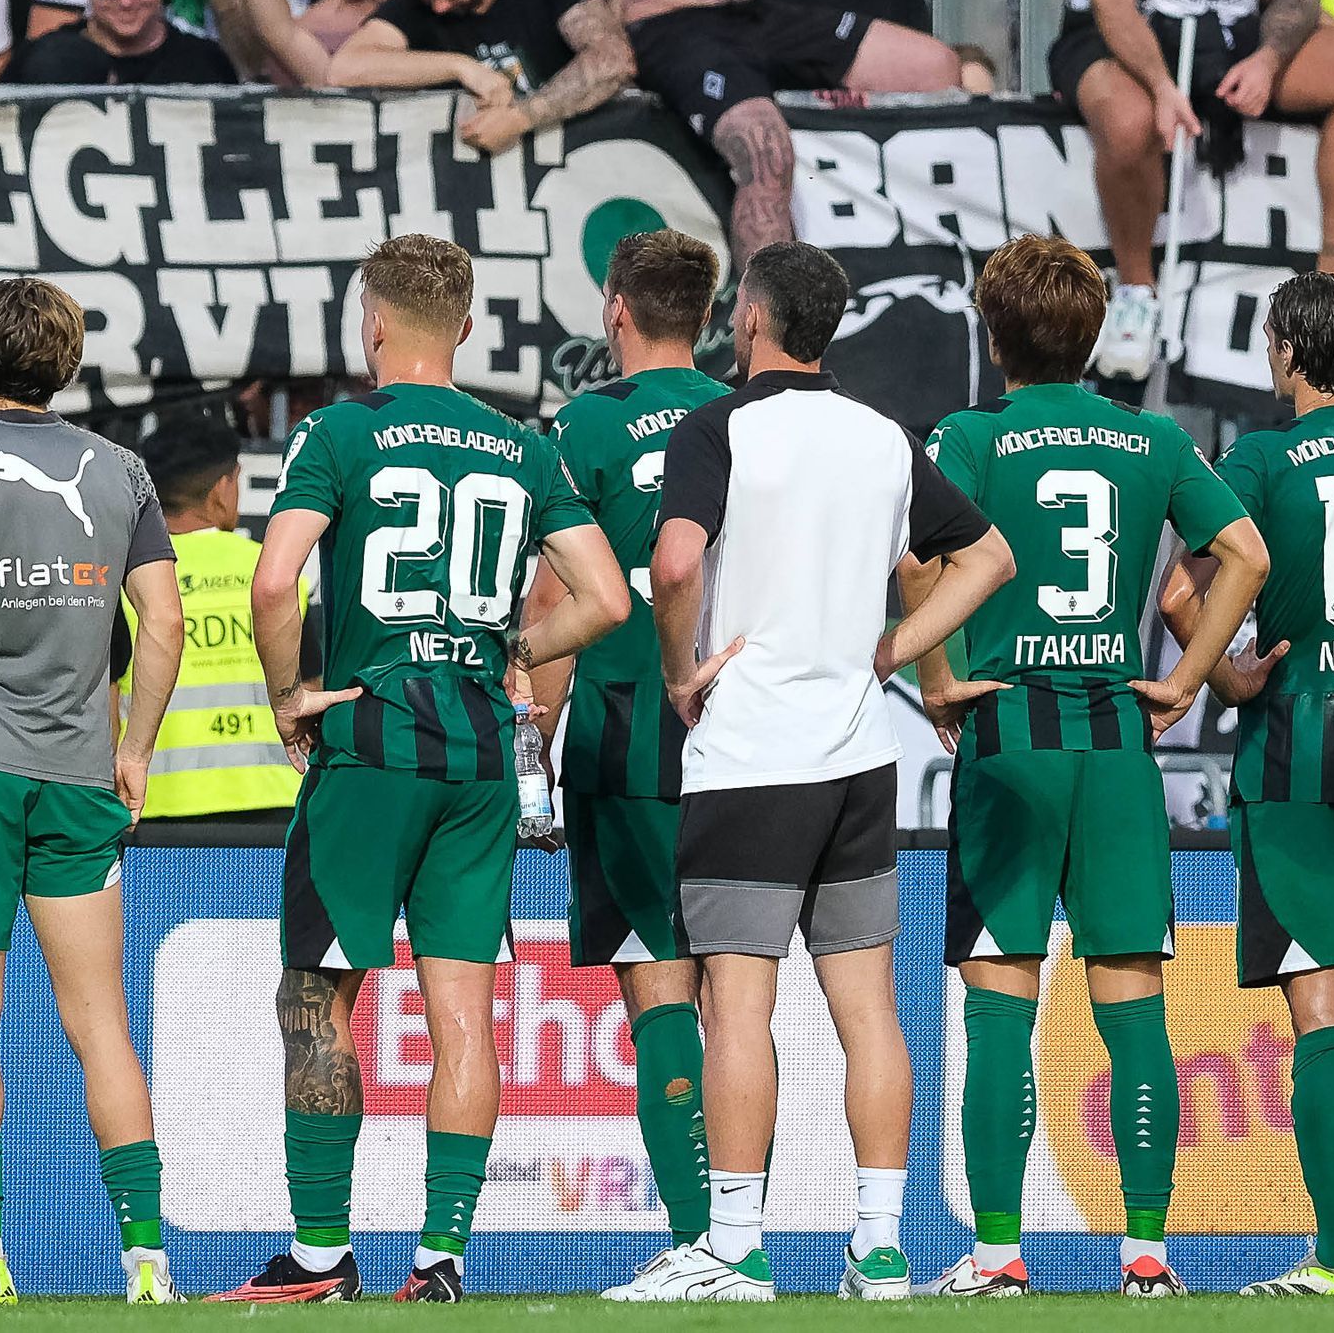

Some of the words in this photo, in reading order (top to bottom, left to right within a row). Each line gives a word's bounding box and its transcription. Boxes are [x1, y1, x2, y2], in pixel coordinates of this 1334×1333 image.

[373, 423, 523, 464] MÖNCHENGLADBACH
[995, 426, 1150, 458] MÖNCHENGLADBACH
[361, 466, 533, 631] 20
[1036, 470, 1119, 624] 3
[1, 597, 46, 610] Anlegen
[48, 595, 65, 607] bei
[67, 596, 85, 607] den
[409, 630, 485, 666] NETZ
[1014, 633, 1126, 666] ITAKURA
[210, 712, 255, 735] 491
